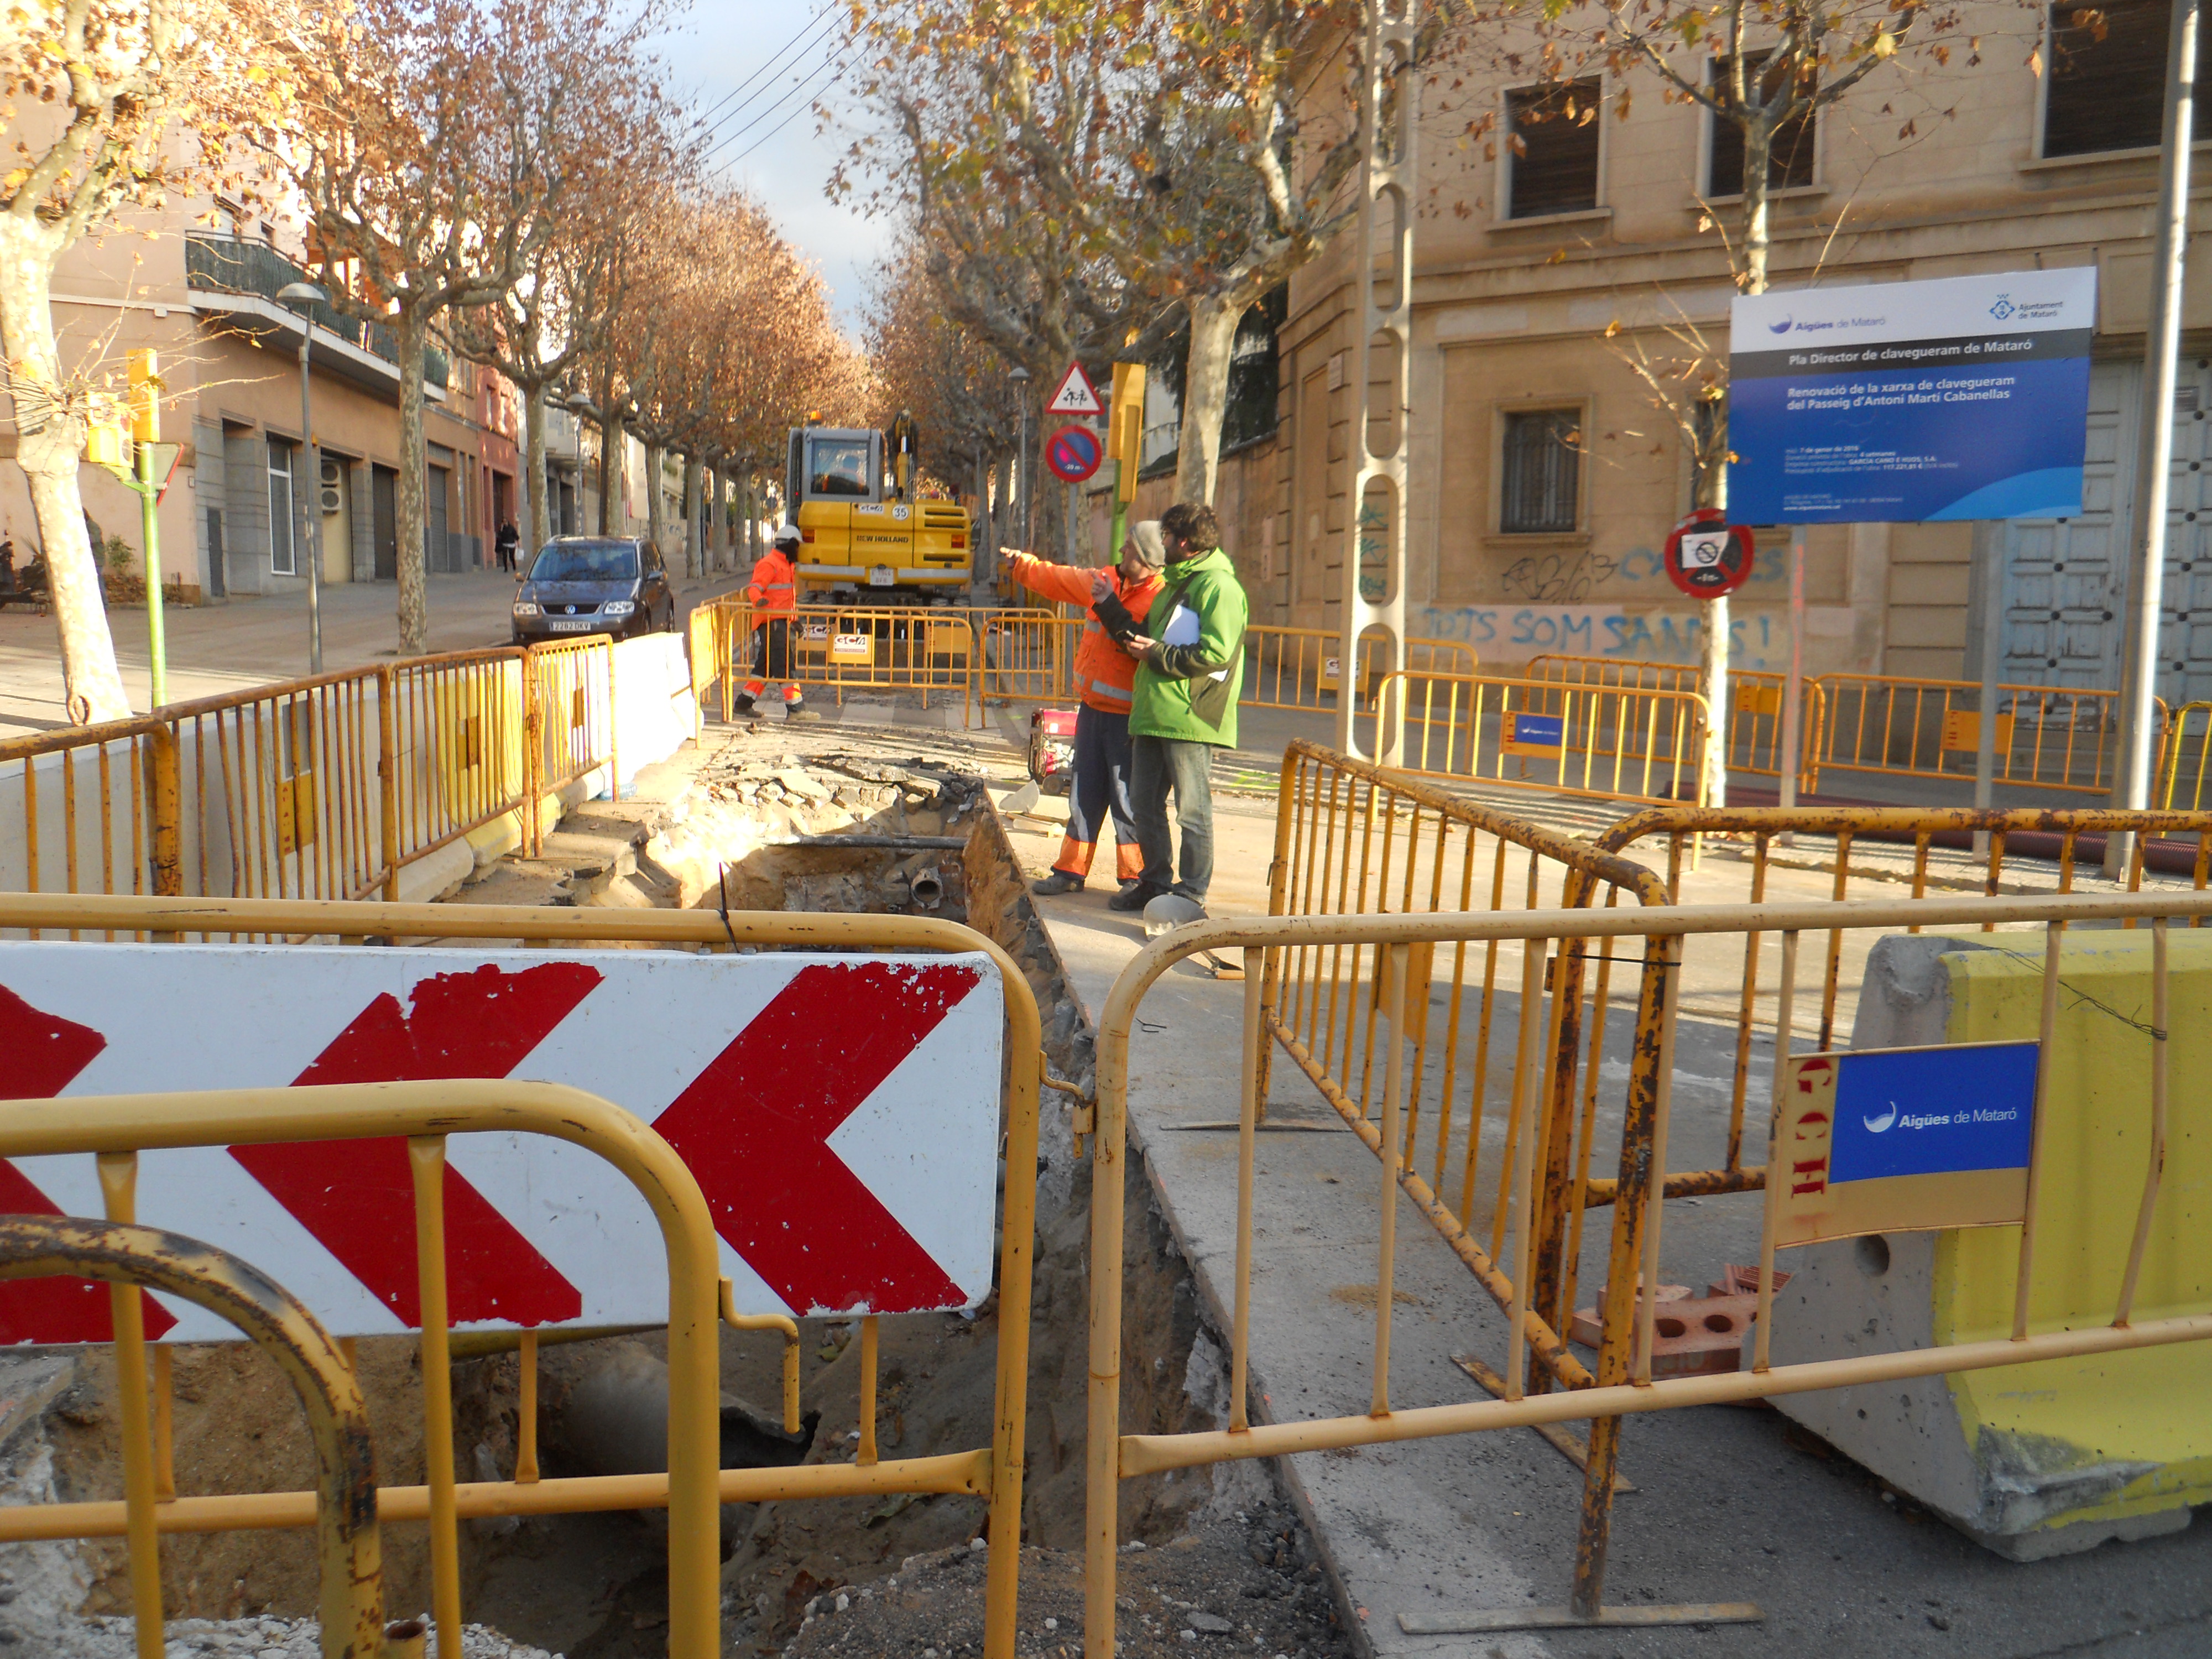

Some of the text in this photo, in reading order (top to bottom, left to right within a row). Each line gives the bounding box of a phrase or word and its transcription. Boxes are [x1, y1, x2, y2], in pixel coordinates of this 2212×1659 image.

[2018, 301, 2063, 311] Ajuntament
[2030, 310, 2057, 319] Mataró
[1795, 316, 1886, 332] Aigües de Mataró
[1789, 340, 2032, 366] Pla Director de clavegueram de Mataró
[1787, 377, 2015, 398] Renovació de la xarxa de clavegueram
[1787, 399, 1804, 410] del
[1808, 397, 1850, 410] Passeig
[1908, 390, 1941, 404] Martí
[1944, 388, 2010, 402] Cabanellas
[894, 508, 907, 518] 35
[1511, 609, 1592, 653] SOM
[1898, 1107, 2017, 1130] Aigües de Mataró
